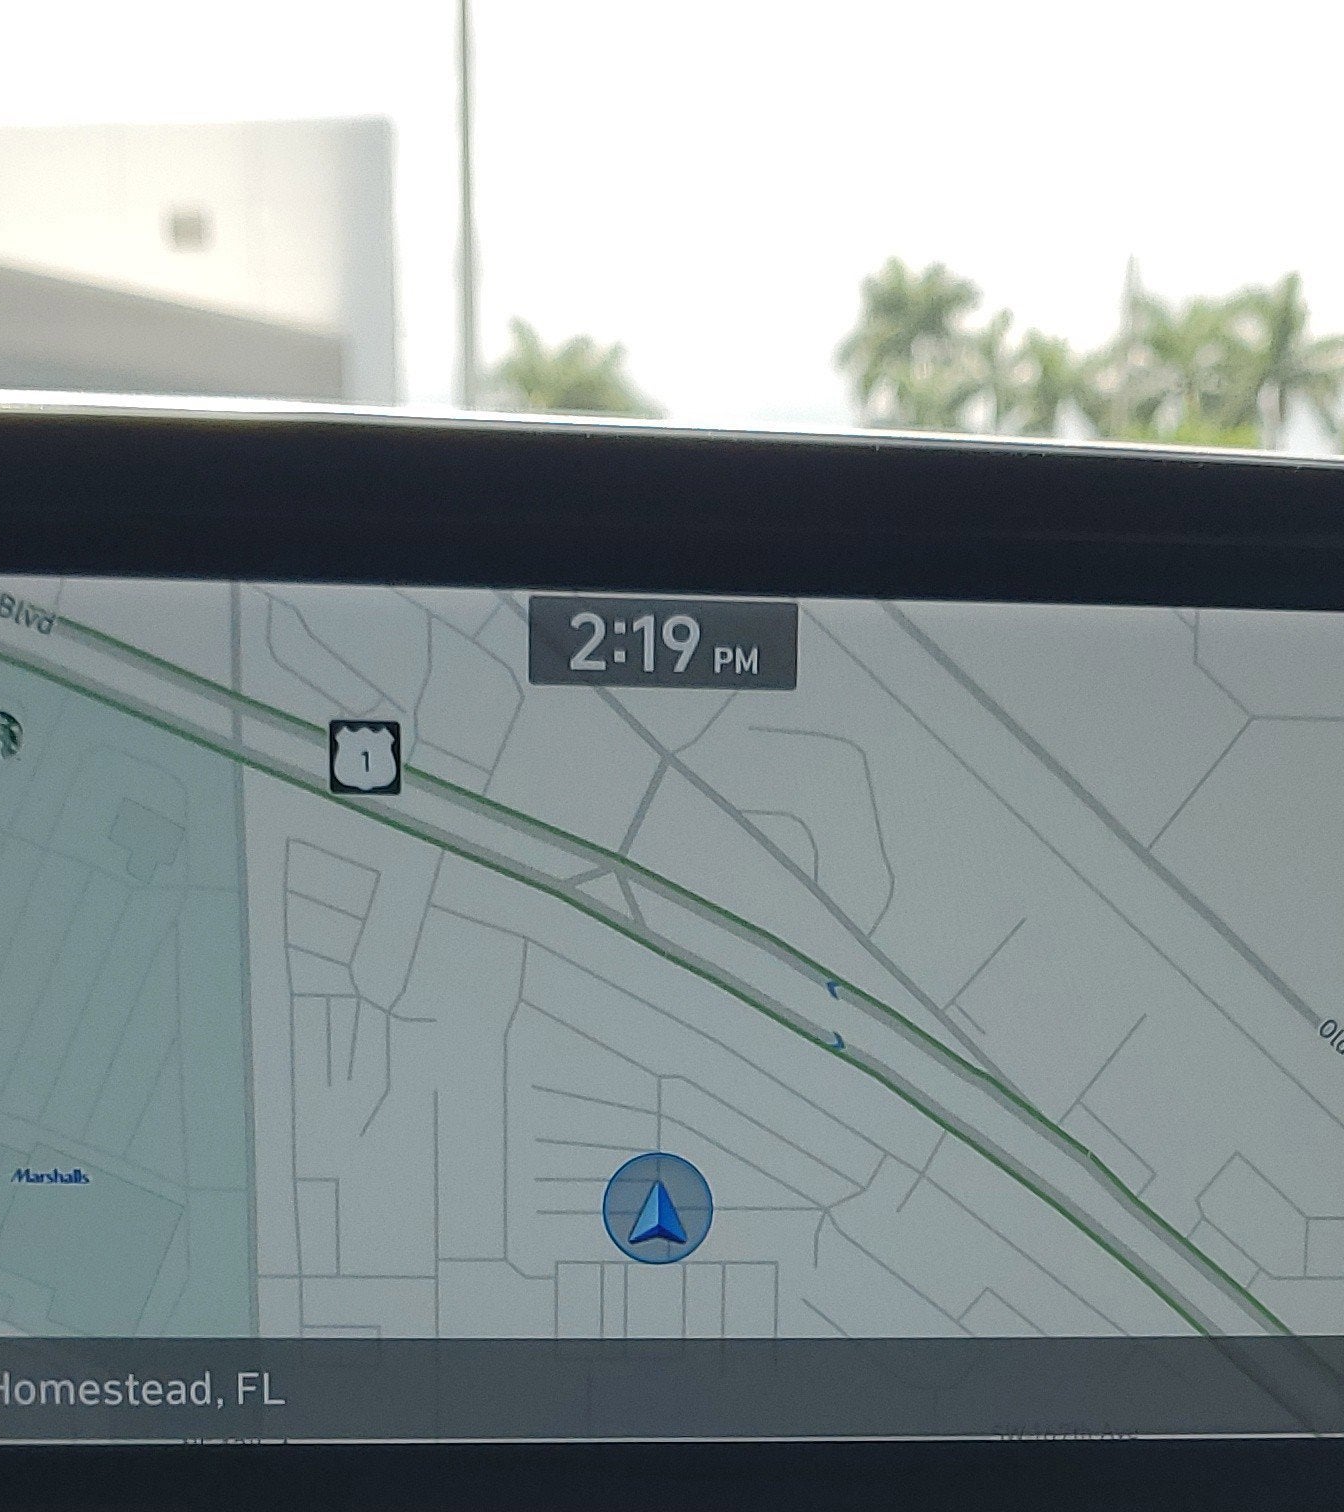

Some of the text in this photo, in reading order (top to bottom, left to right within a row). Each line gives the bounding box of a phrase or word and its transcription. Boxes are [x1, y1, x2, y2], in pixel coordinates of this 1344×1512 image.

[567, 612, 759, 676] 2:19 PM
[360, 750, 370, 773] 1
[10, 1167, 91, 1185] Marshalls
[237, 1373, 287, 1407] FL
